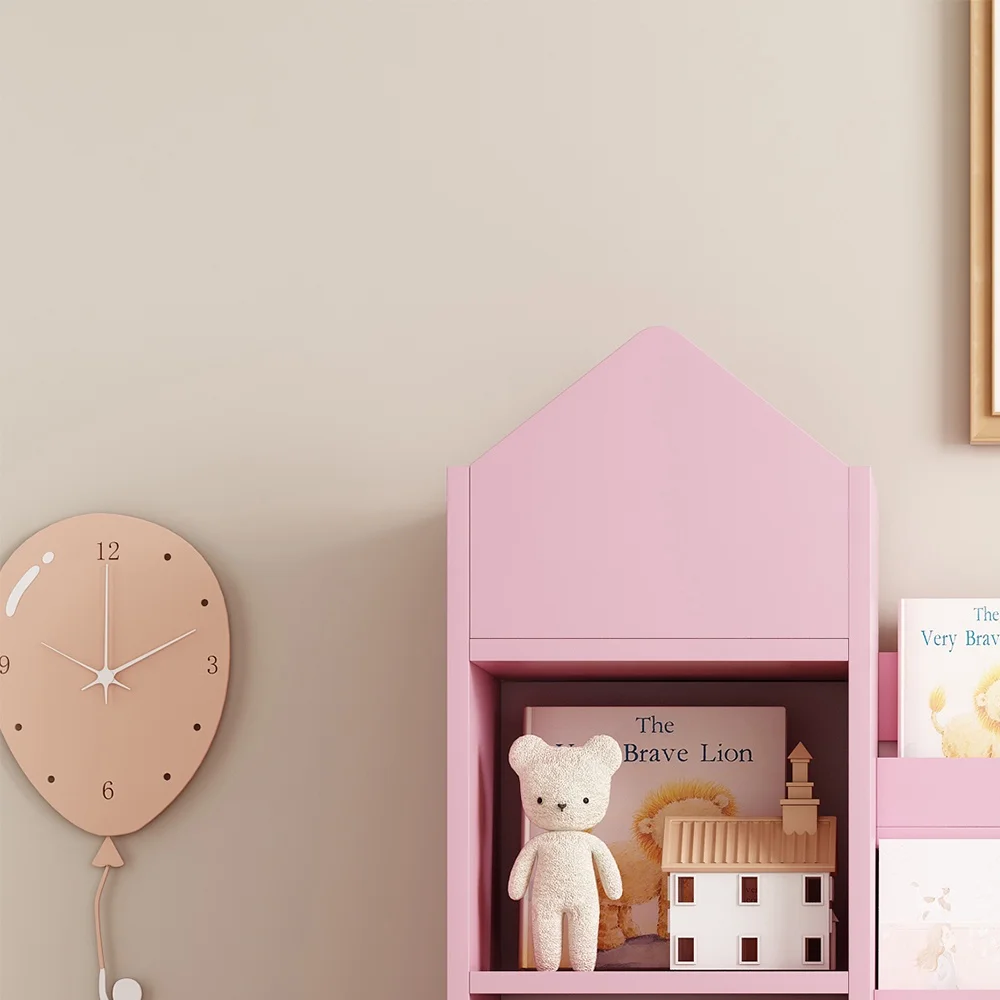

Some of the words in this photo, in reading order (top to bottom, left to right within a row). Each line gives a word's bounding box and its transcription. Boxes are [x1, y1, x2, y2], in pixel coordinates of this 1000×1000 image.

[97, 541, 120, 561] 12
[974, 606, 999, 621] The
[921, 630, 957, 652] Very
[0, 655, 10, 675] 9
[207, 655, 218, 675] 3
[636, 715, 674, 733] The
[624, 743, 688, 762] Brave
[701, 742, 753, 762] Lion
[102, 780, 114, 800] 6
